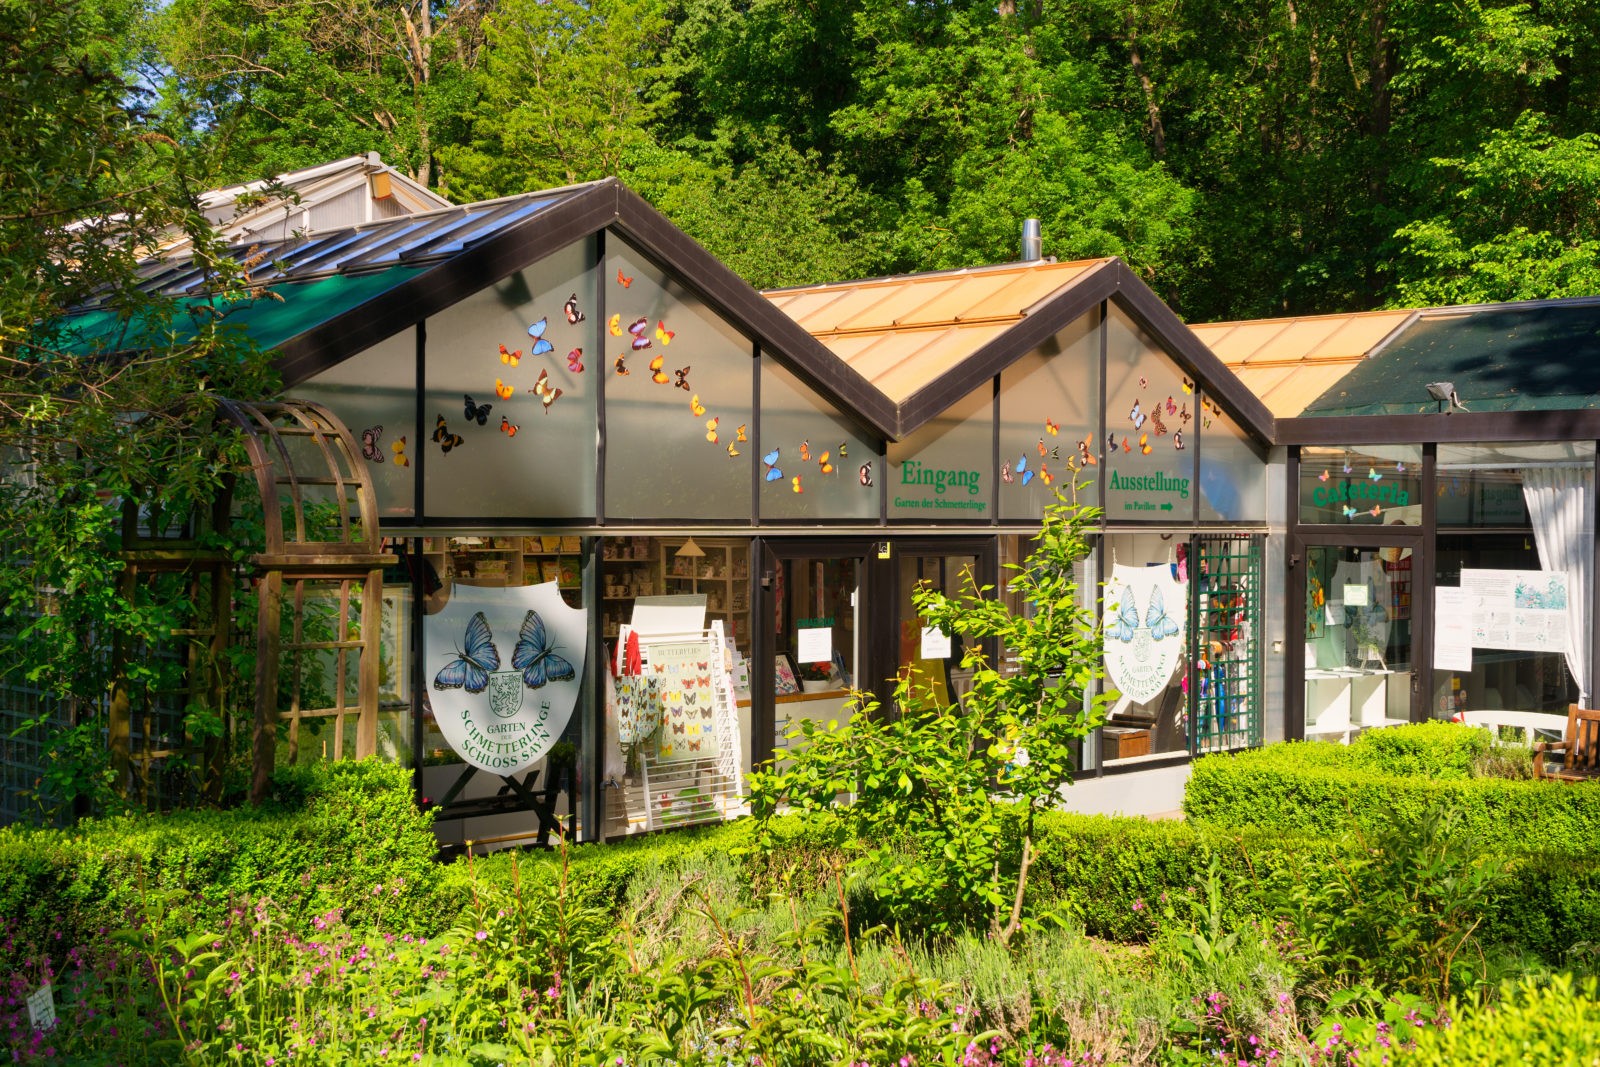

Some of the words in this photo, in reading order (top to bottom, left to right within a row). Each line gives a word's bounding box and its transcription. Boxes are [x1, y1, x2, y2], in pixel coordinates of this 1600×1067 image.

[901, 461, 980, 494] Eingang
[1109, 470, 1190, 499] Ausstellung
[894, 497, 920, 508] Garten
[921, 497, 933, 508] der
[934, 498, 987, 512] Schmetterlinge
[1124, 501, 1133, 510] im
[1312, 481, 1409, 507] Cafeteria
[460, 701, 551, 755] SCHMETTERLINGE
[487, 722, 526, 735] GARTEN
[461, 739, 518, 769] SCHLOSS
[521, 729, 551, 761] SAYN
